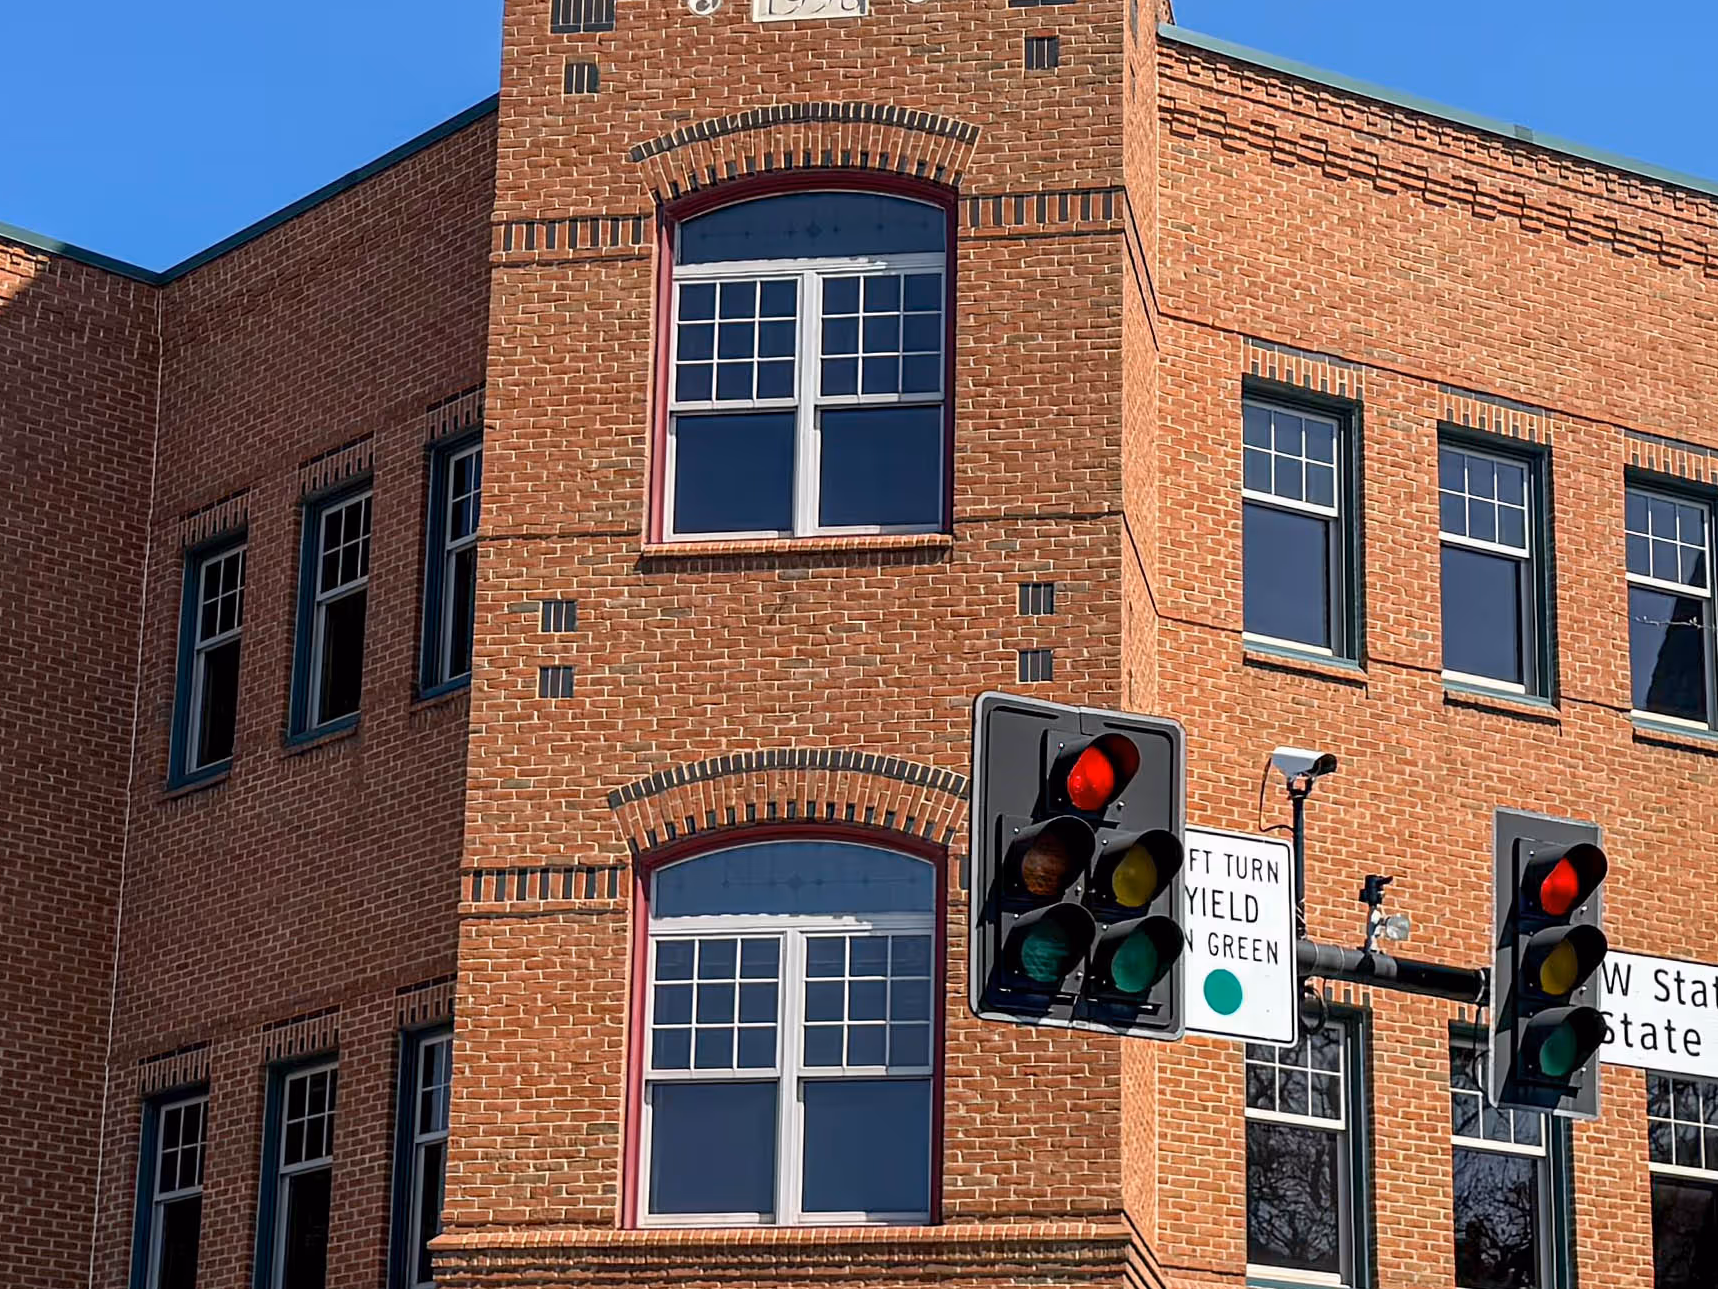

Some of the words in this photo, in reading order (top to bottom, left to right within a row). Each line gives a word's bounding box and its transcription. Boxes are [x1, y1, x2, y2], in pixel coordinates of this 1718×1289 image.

[1189, 848, 1213, 875] FT
[1223, 853, 1280, 885] TURN
[1185, 884, 1259, 924] YIELD
[1184, 928, 1193, 953] N
[1207, 931, 1279, 965] GREEN
[1601, 960, 1631, 997] W
[1601, 1011, 1702, 1058] State
